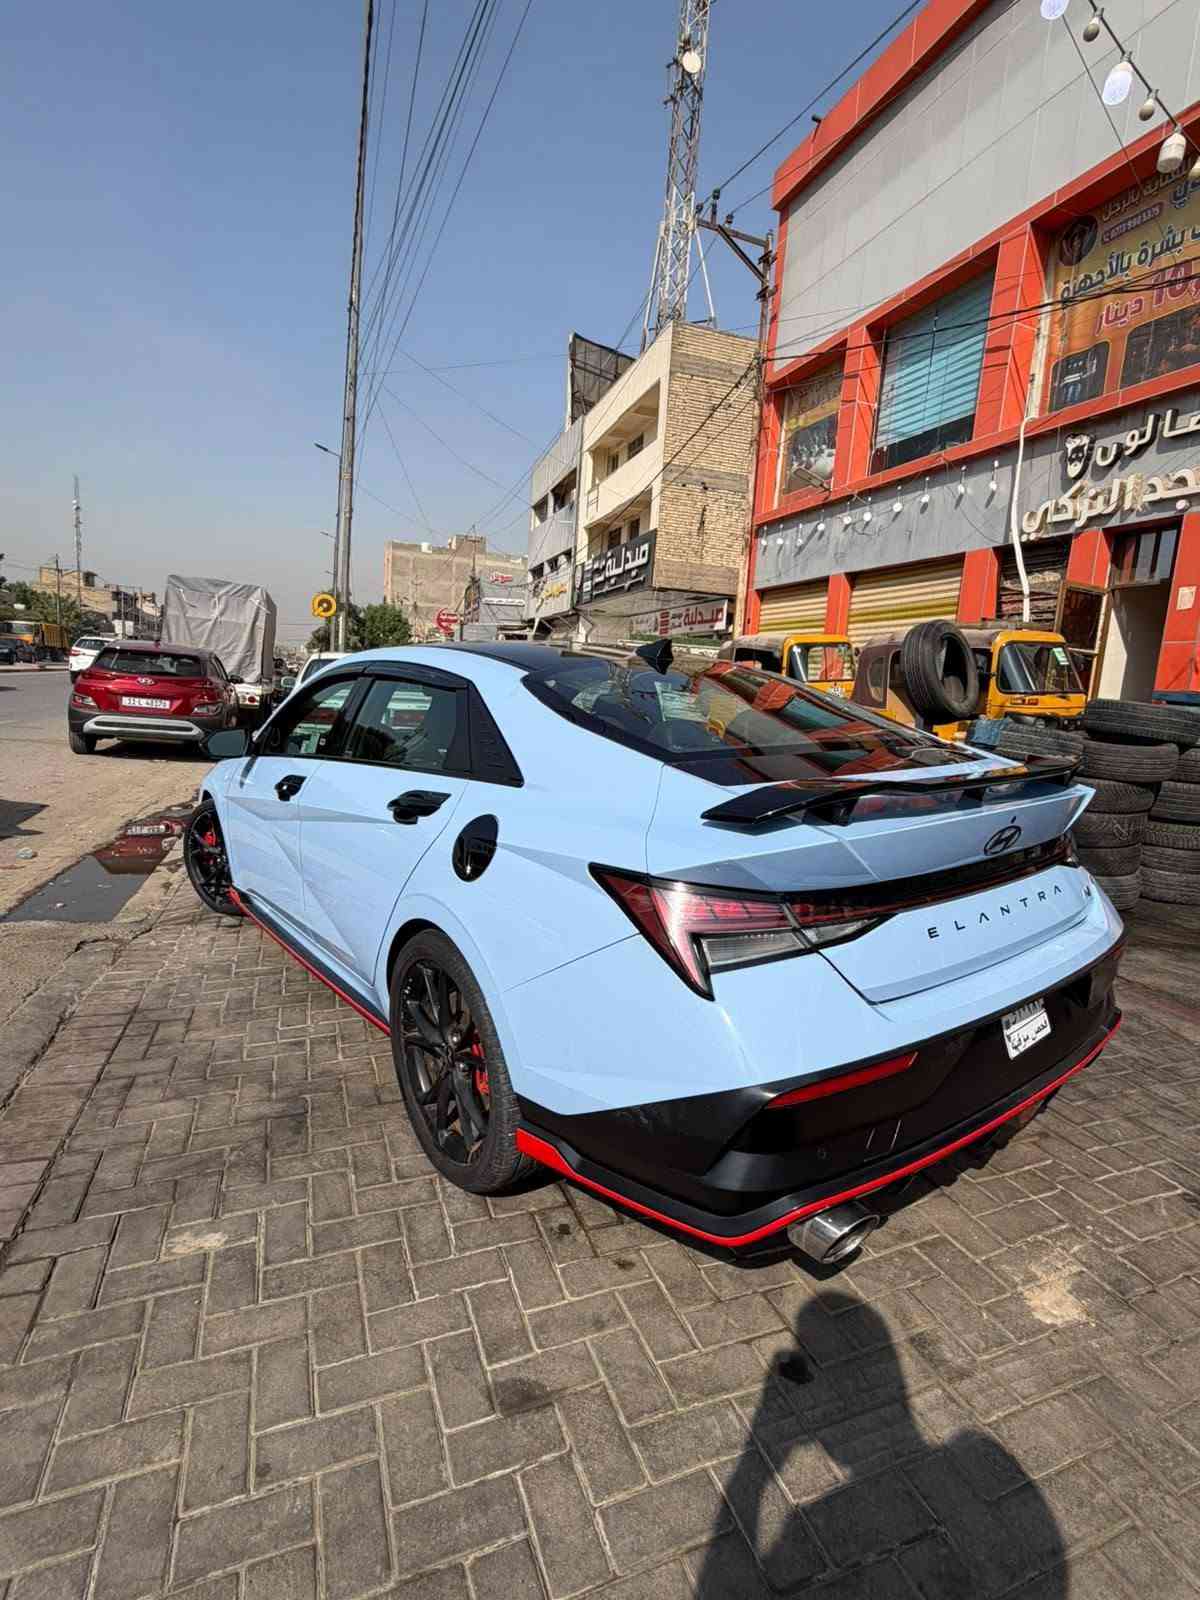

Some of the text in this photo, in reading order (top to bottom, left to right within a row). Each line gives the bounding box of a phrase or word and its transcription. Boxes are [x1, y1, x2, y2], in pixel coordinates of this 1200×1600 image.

[1094, 296, 1145, 337] دينار
[605, 543, 649, 585] صيدلية
[683, 606, 724, 631] صيدلية
[927, 884, 1063, 939] ELANTRA
